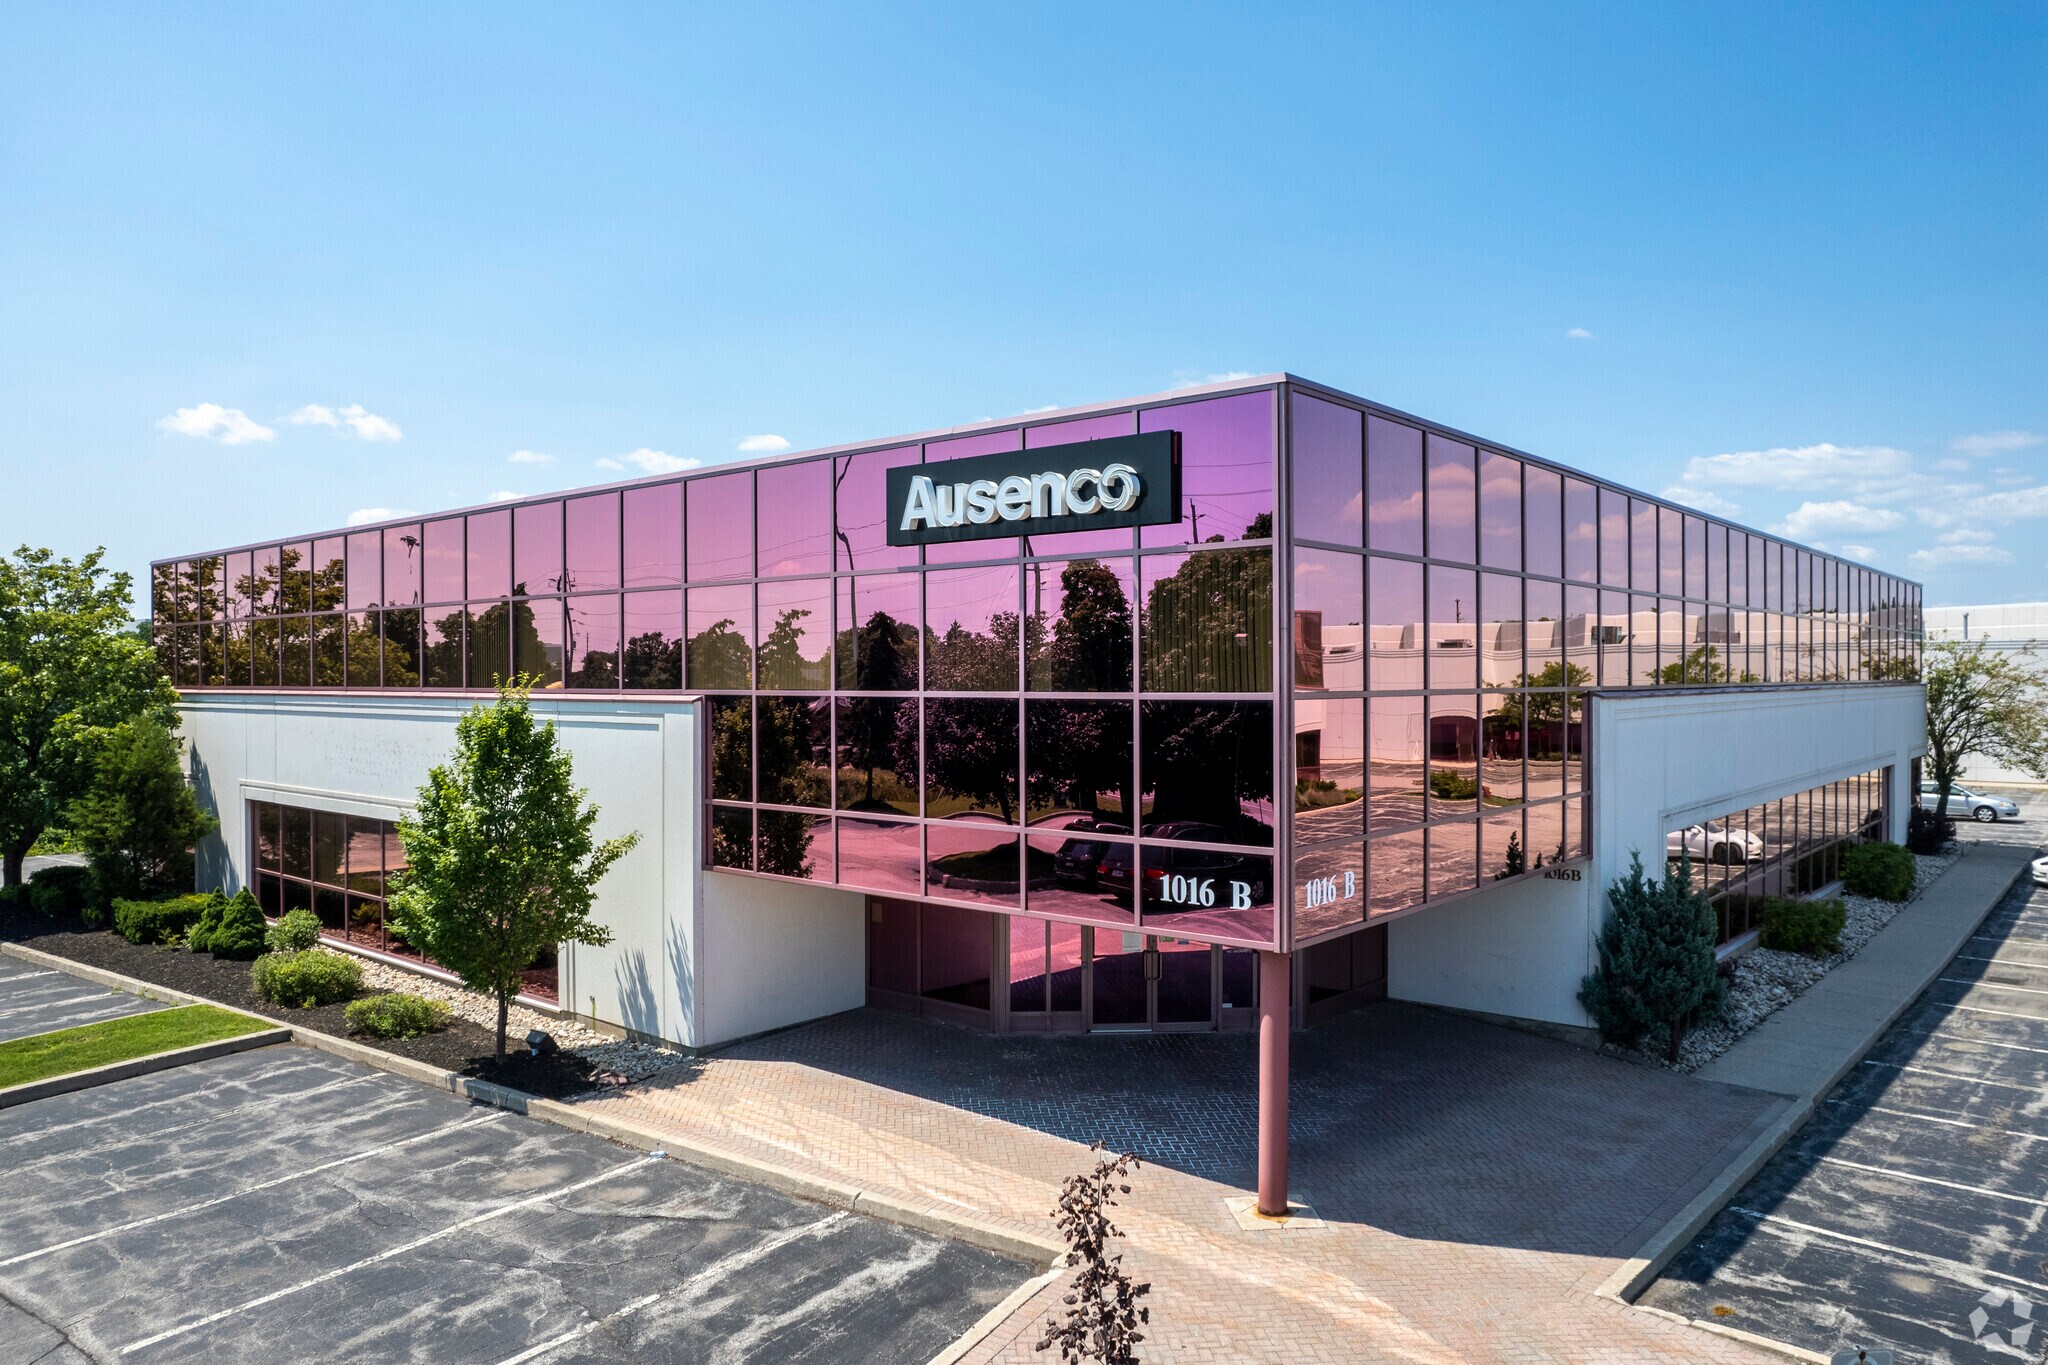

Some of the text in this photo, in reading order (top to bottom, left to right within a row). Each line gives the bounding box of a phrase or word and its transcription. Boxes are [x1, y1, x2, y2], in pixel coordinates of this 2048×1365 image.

[900, 463, 1141, 531] Ausenco
[1159, 874, 1252, 911] 1016 B
[1305, 871, 1355, 910] 1016 B
